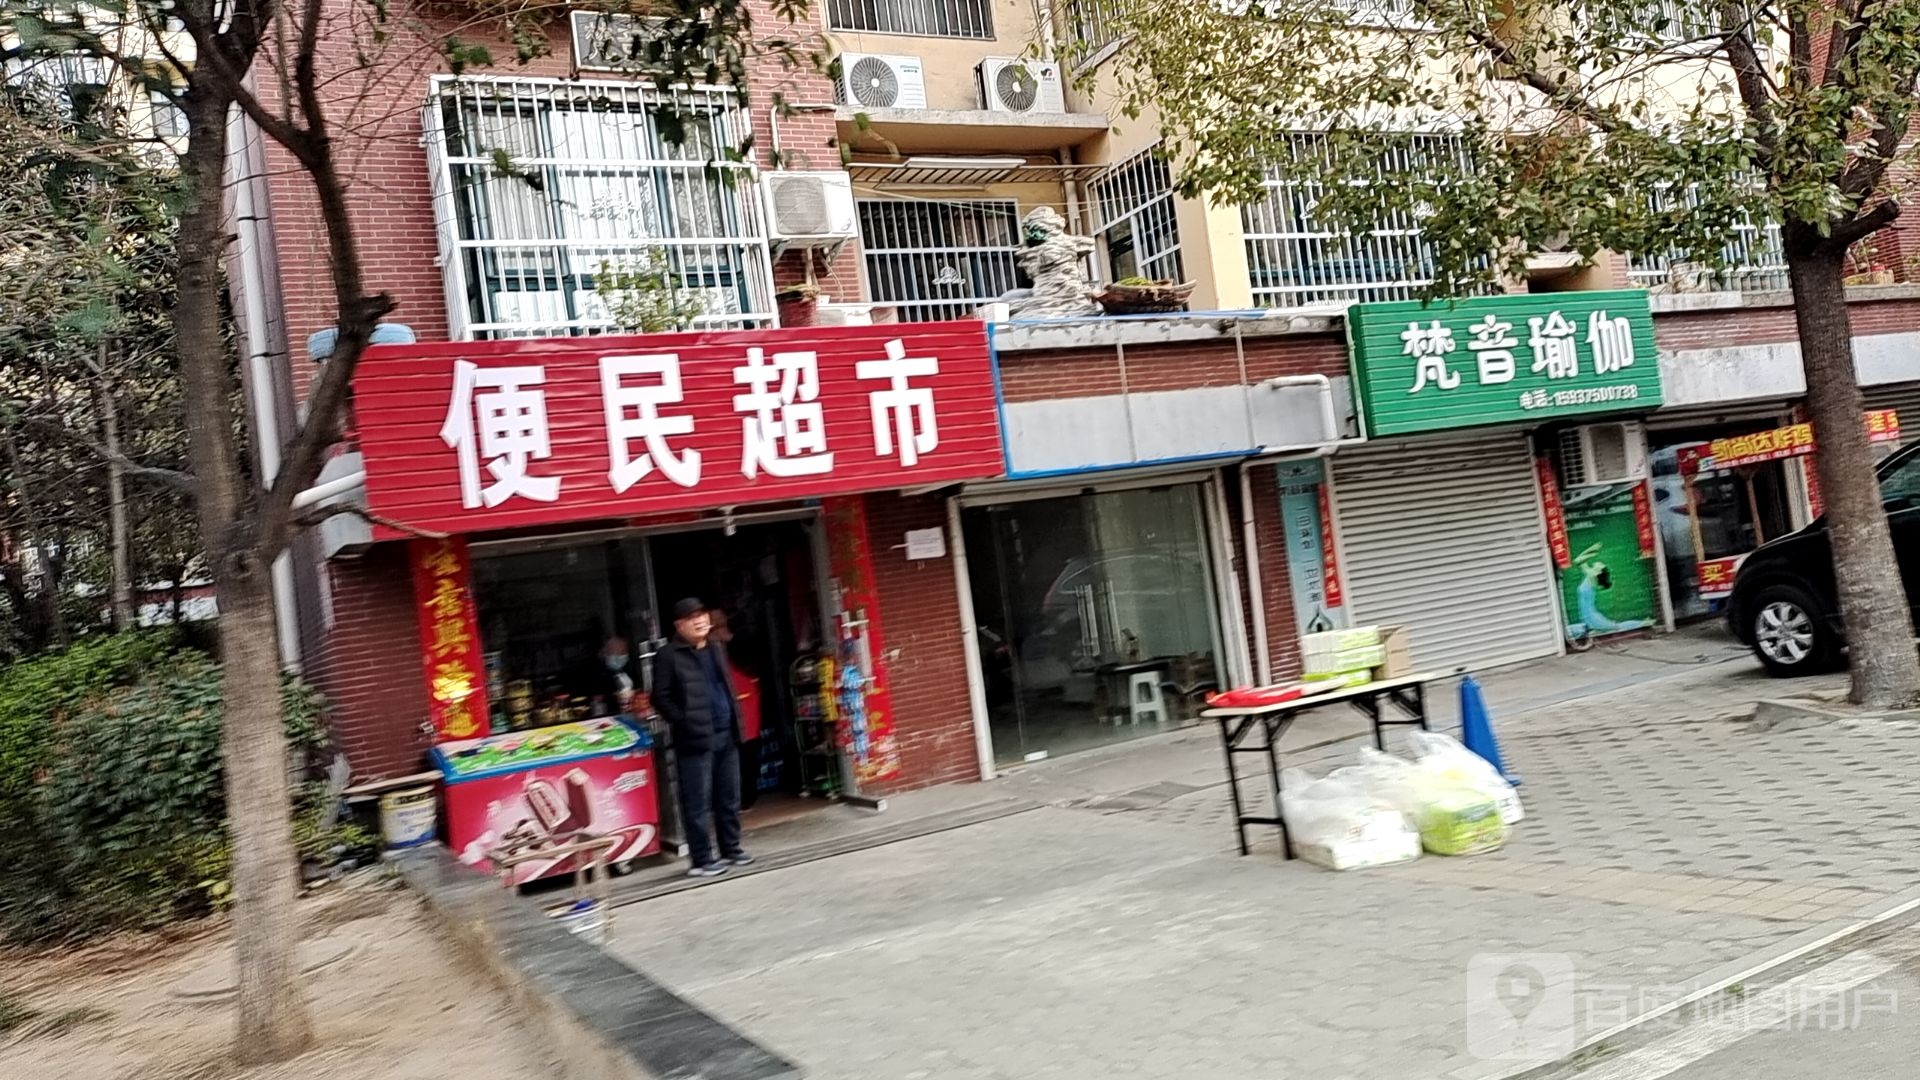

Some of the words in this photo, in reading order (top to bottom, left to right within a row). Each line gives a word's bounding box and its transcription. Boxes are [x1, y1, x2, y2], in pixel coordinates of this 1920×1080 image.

[1400, 309, 1636, 394] 梵音瑜伽
[439, 337, 940, 510] 便民超市
